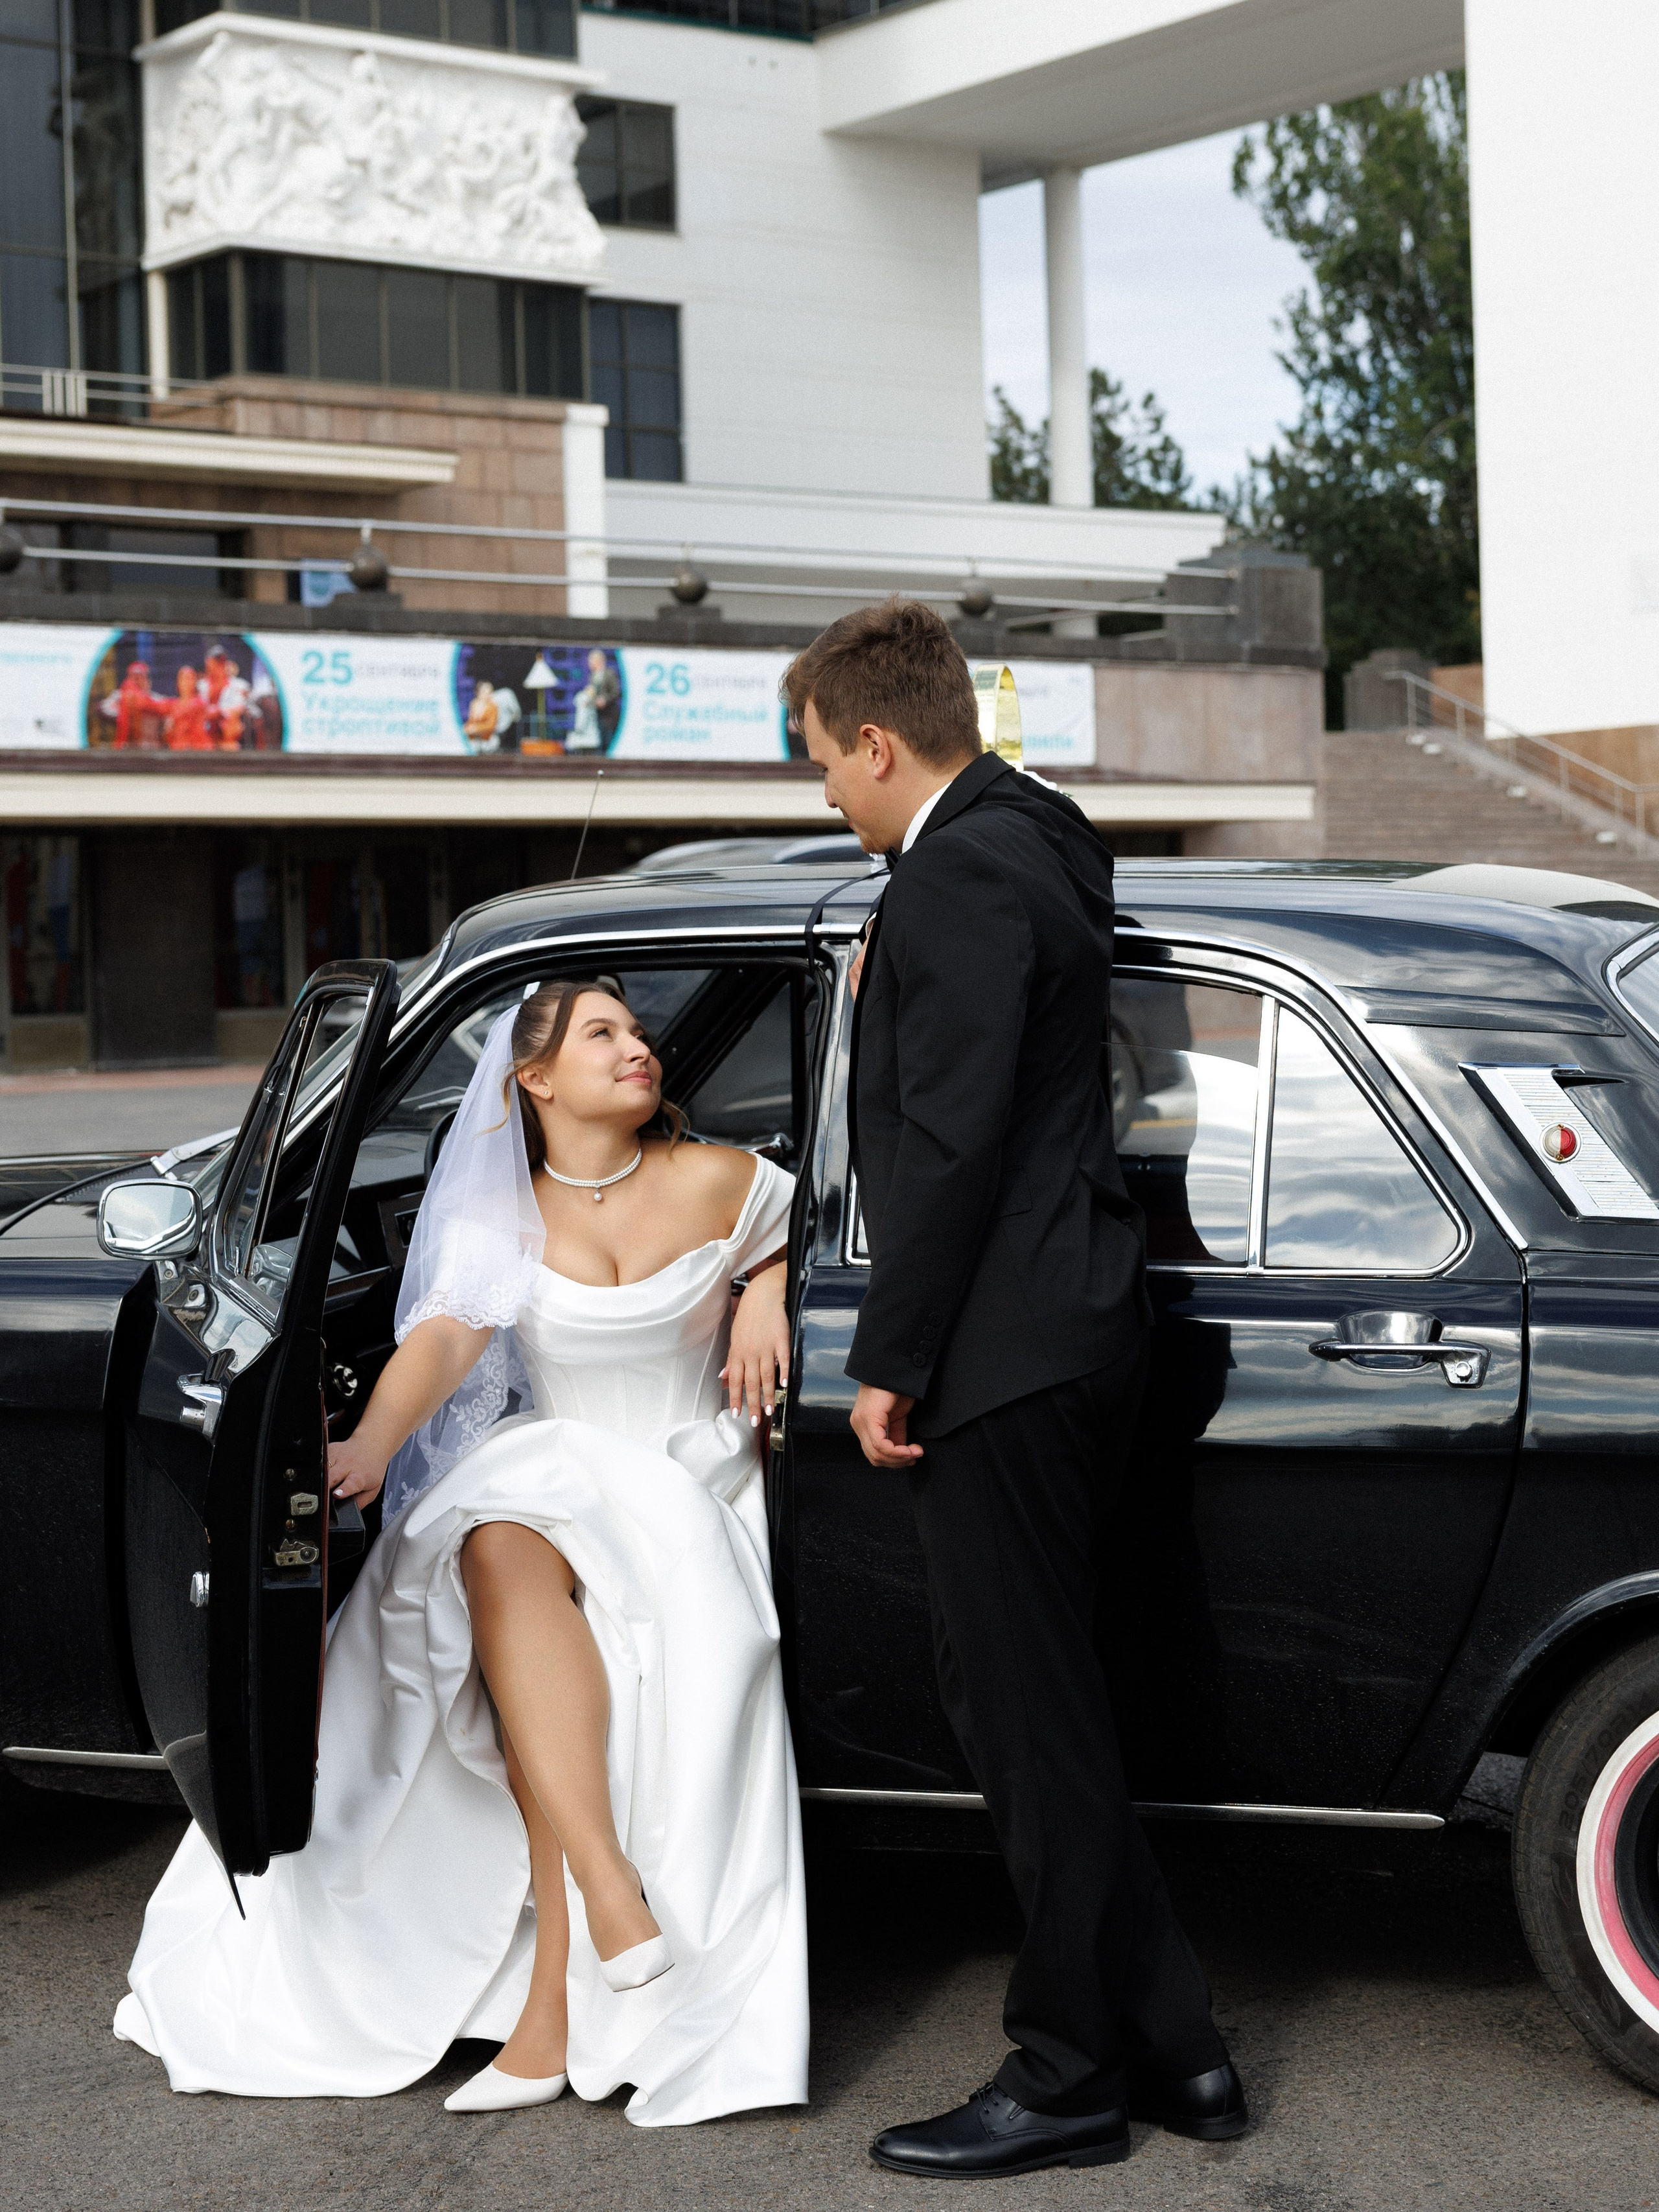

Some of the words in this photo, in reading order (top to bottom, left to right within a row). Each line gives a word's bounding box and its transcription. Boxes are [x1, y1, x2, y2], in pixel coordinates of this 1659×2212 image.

[303, 651, 353, 684] 25
[646, 663, 690, 695] 26
[303, 692, 437, 714] Укрощение
[644, 701, 767, 725] Служебный
[303, 717, 439, 736] строптивой
[644, 726, 710, 745] роман
